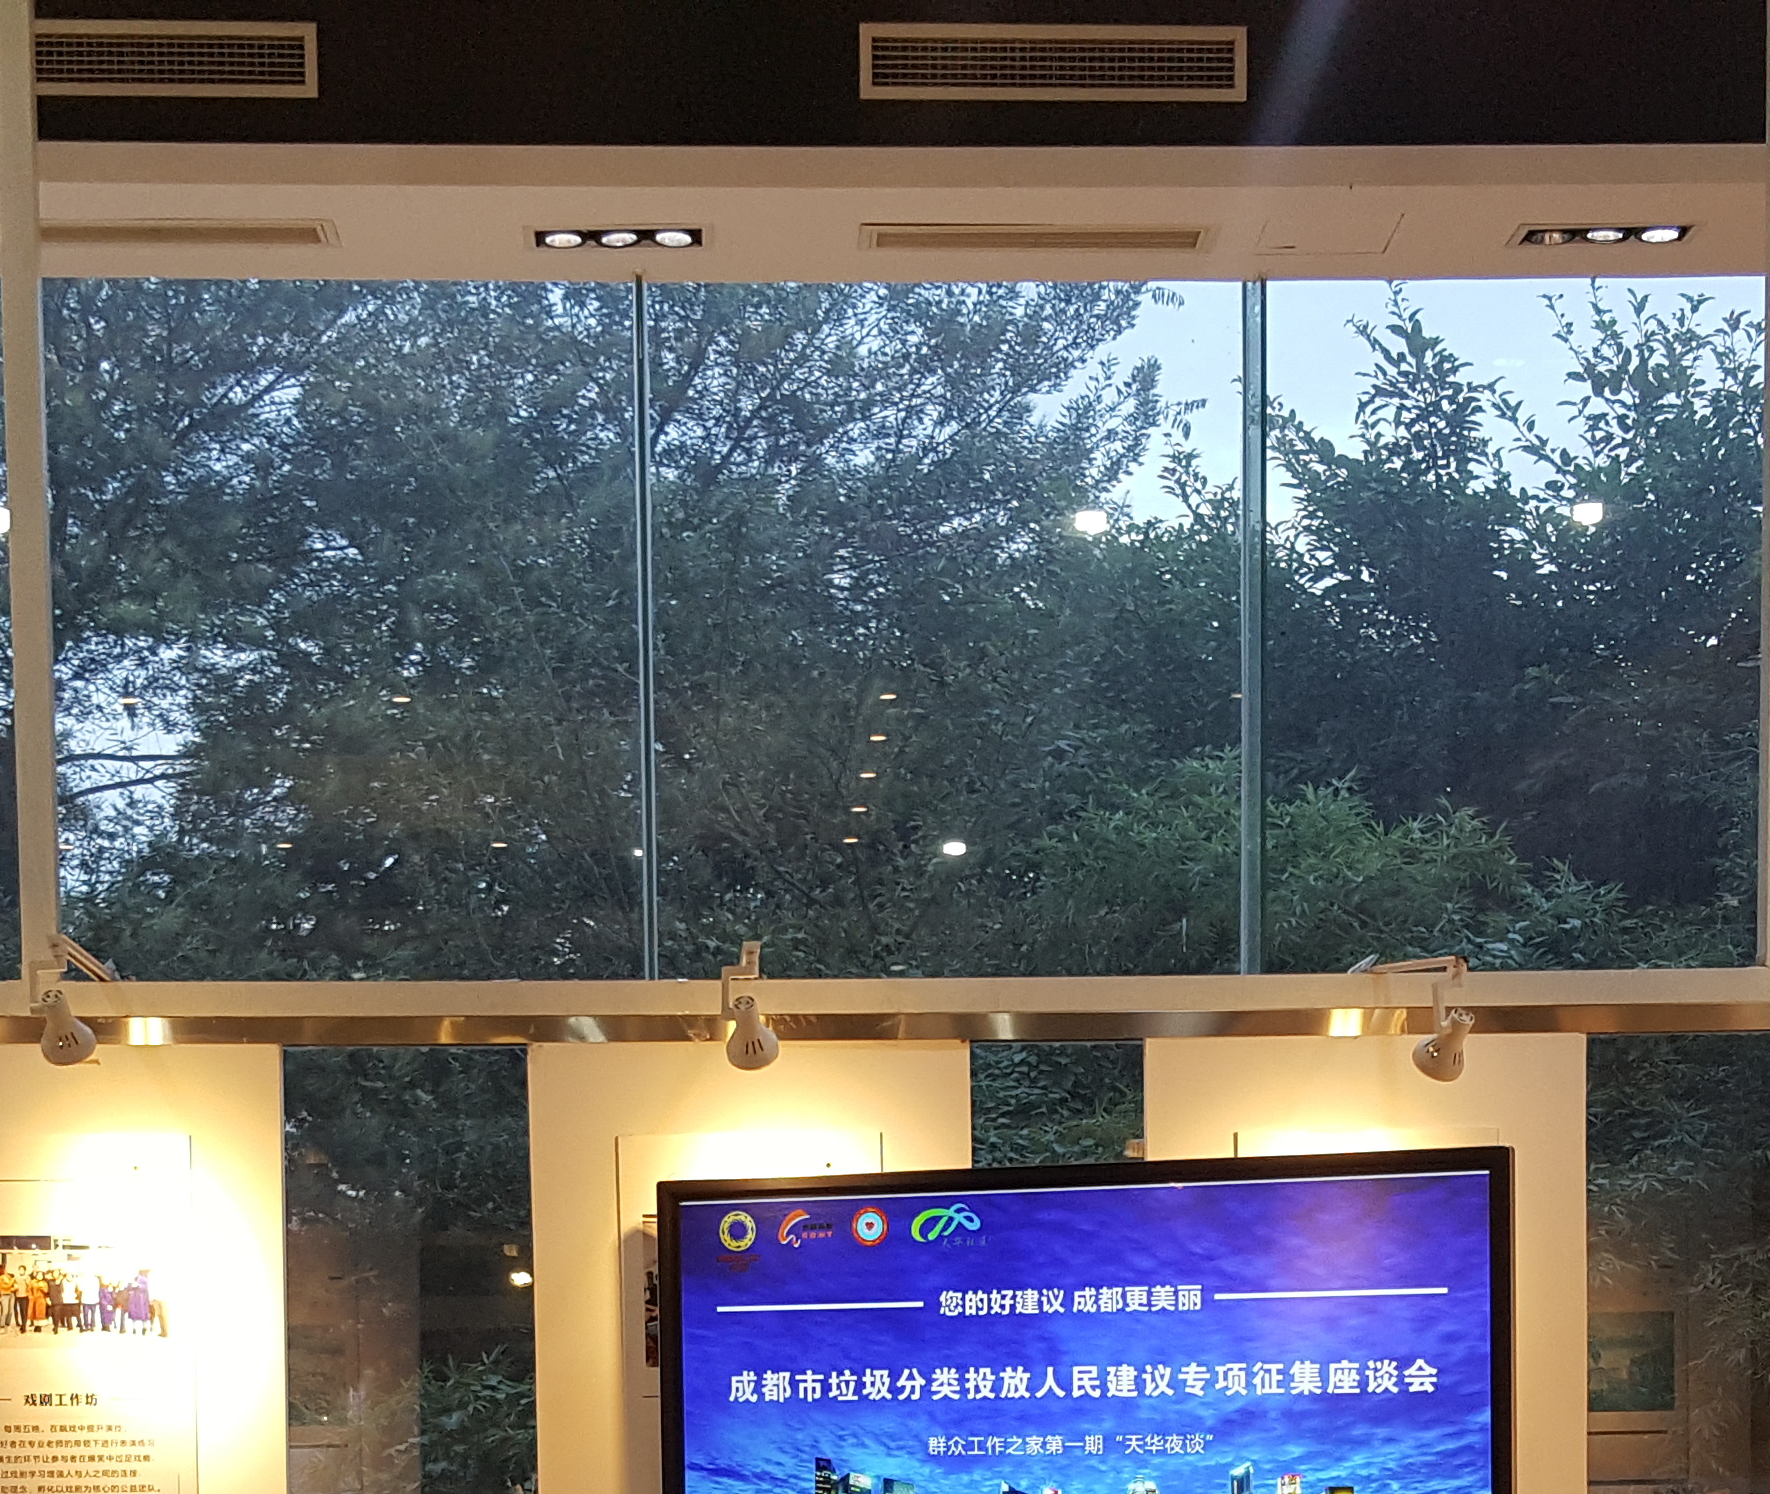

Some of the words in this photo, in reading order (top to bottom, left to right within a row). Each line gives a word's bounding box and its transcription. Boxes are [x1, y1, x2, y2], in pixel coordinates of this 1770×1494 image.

[939, 1288, 1065, 1316] 您的好建议
[1072, 1284, 1203, 1313] 成都更美丽
[728, 1357, 1440, 1404] 成都市垃圾分类投放人民建议专项征集座谈会
[23, 1393, 98, 1407] 戏剧工作坊
[928, 1434, 1214, 1456] 群众工作之家第一期“天华夜谈”
